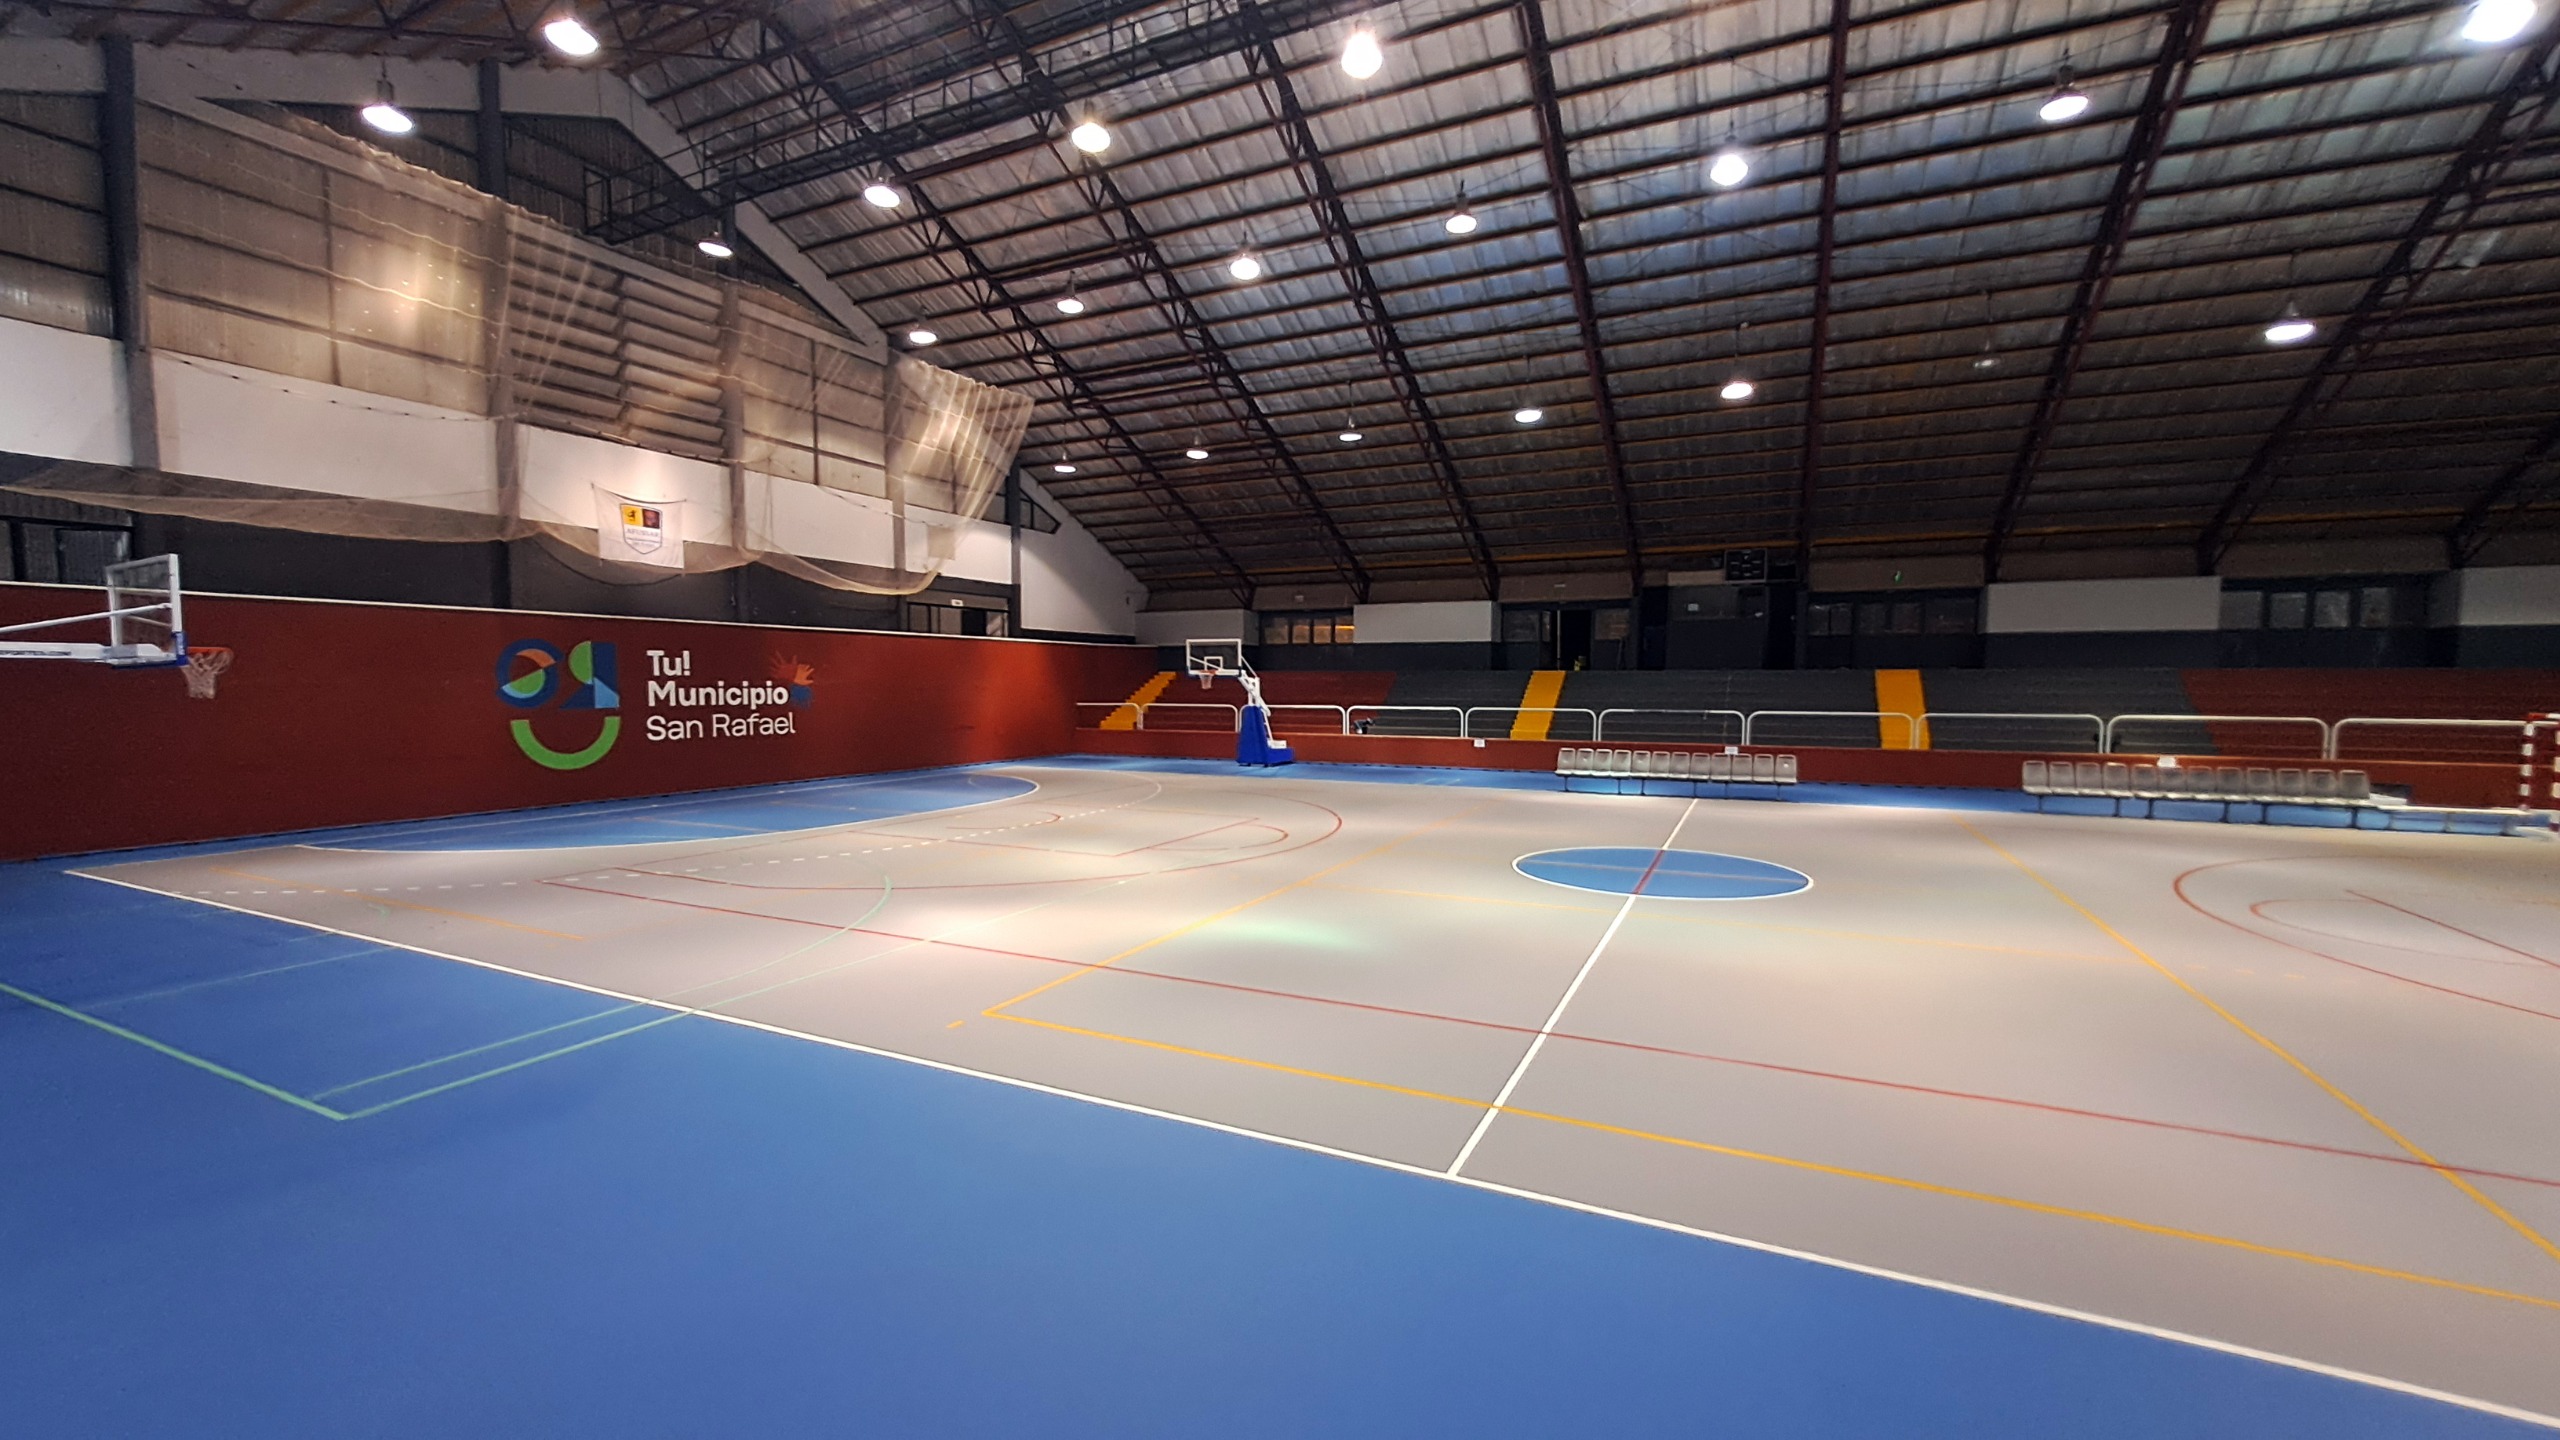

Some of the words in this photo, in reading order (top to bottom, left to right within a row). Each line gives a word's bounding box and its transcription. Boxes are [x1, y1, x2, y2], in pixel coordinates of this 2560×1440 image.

[646, 649, 691, 677] Tu!
[647, 680, 790, 710] Municipio
[646, 715, 704, 741] San
[712, 711, 797, 738] Rafael
